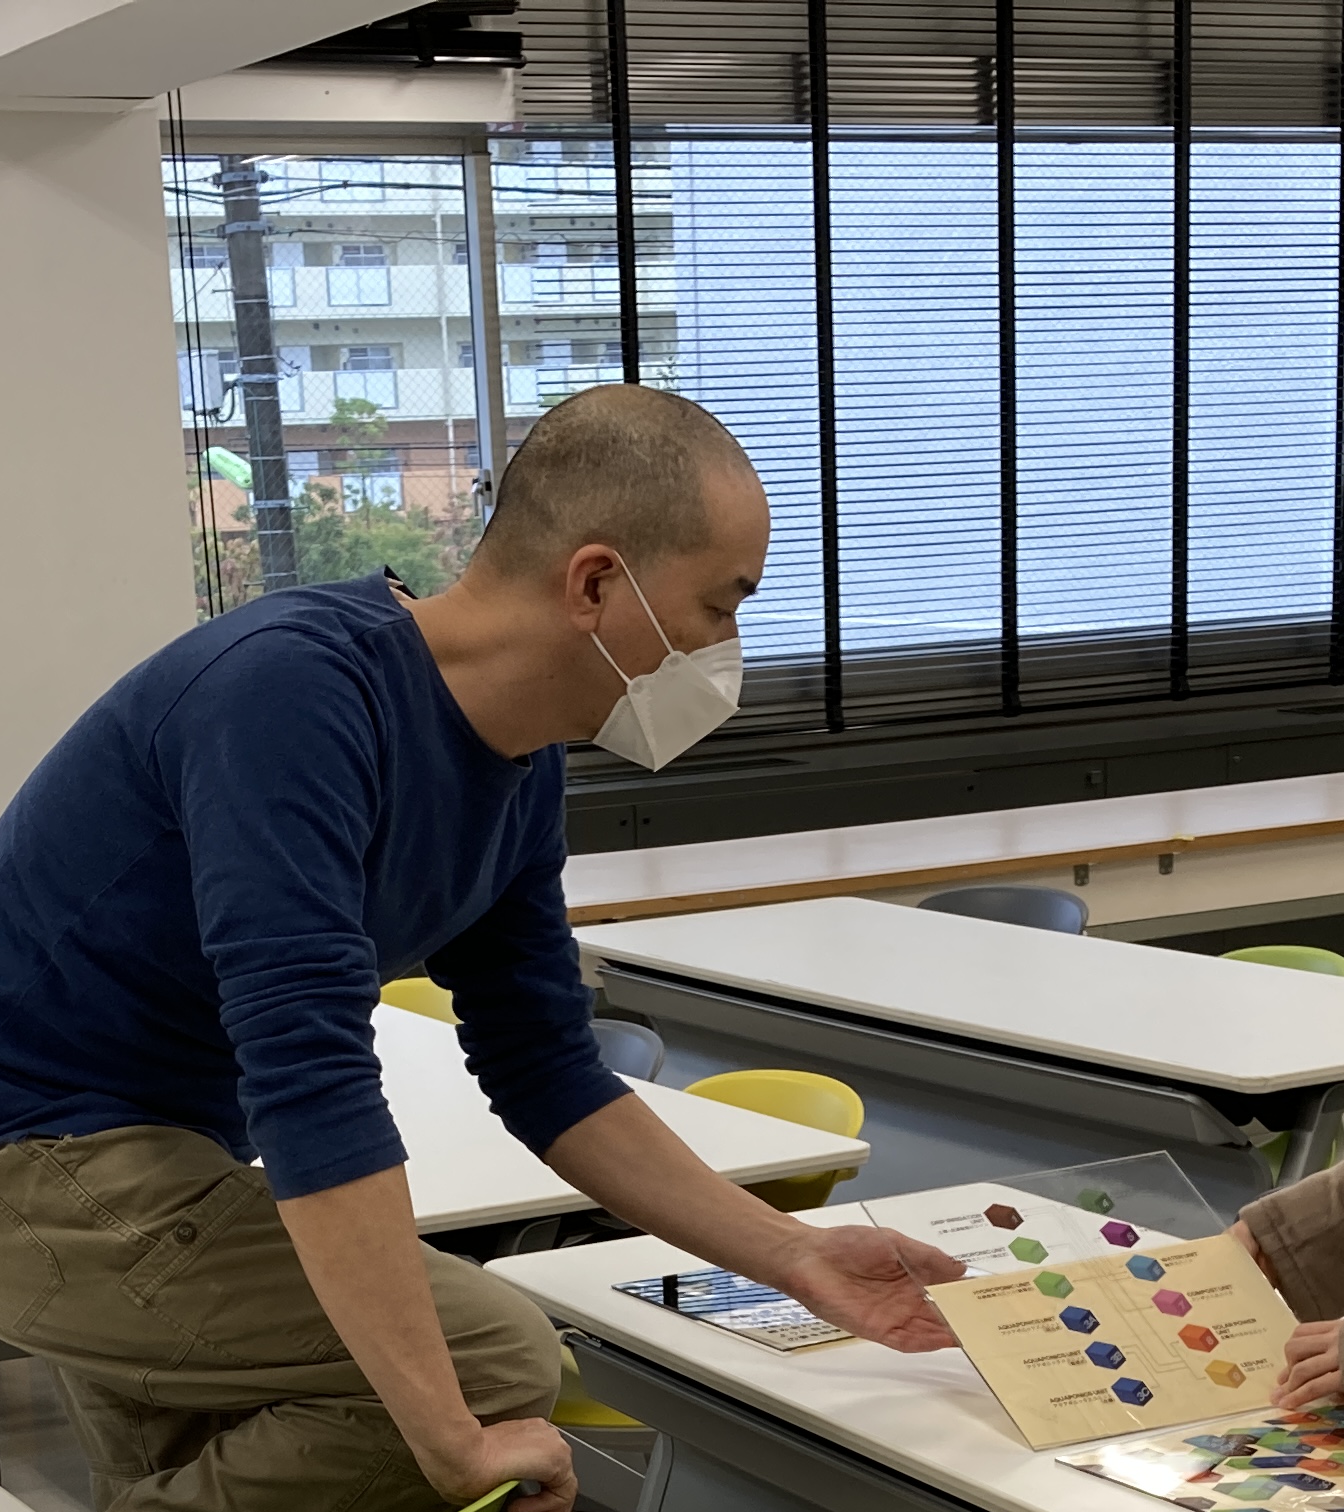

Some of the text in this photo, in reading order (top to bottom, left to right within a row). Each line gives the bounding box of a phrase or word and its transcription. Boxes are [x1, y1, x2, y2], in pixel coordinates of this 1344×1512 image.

[1078, 1314, 1100, 1329] 3A
[1105, 1350, 1126, 1365] 3B
[1132, 1386, 1153, 1401] 3C
